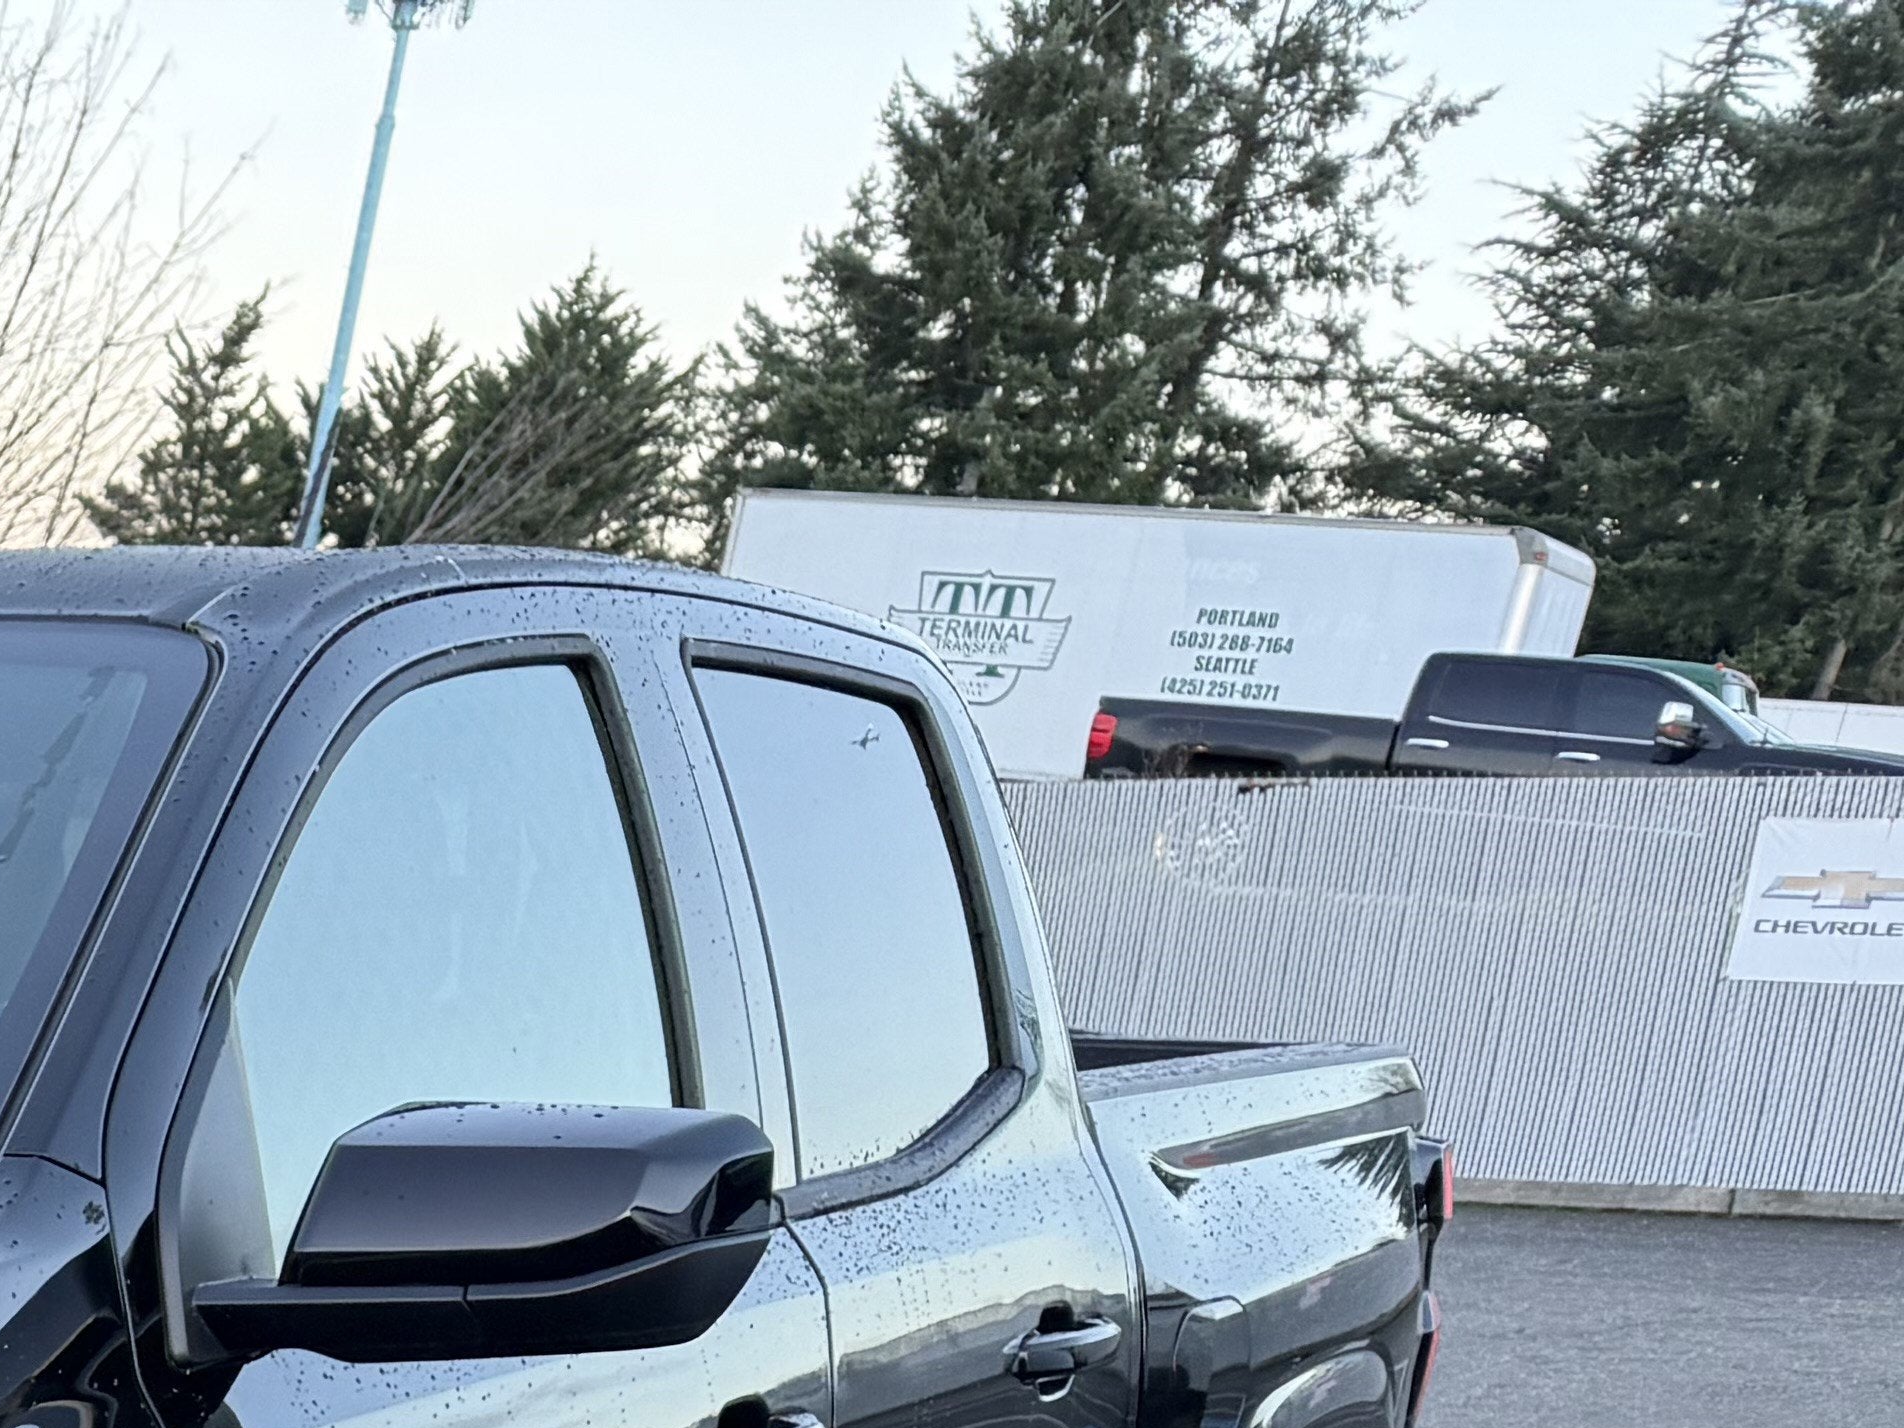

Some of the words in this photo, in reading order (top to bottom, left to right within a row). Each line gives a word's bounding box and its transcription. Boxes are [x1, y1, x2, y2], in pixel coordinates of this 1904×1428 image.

[917, 616, 1035, 645] TERMINAL
[1195, 607, 1281, 629] PORTLAND
[1169, 630, 1216, 650] (503)
[1217, 632, 1295, 655] 288-7164
[1193, 655, 1259, 676] SEATTLE
[1160, 676, 1206, 697] (425)
[1206, 679, 1281, 702] 251-0371
